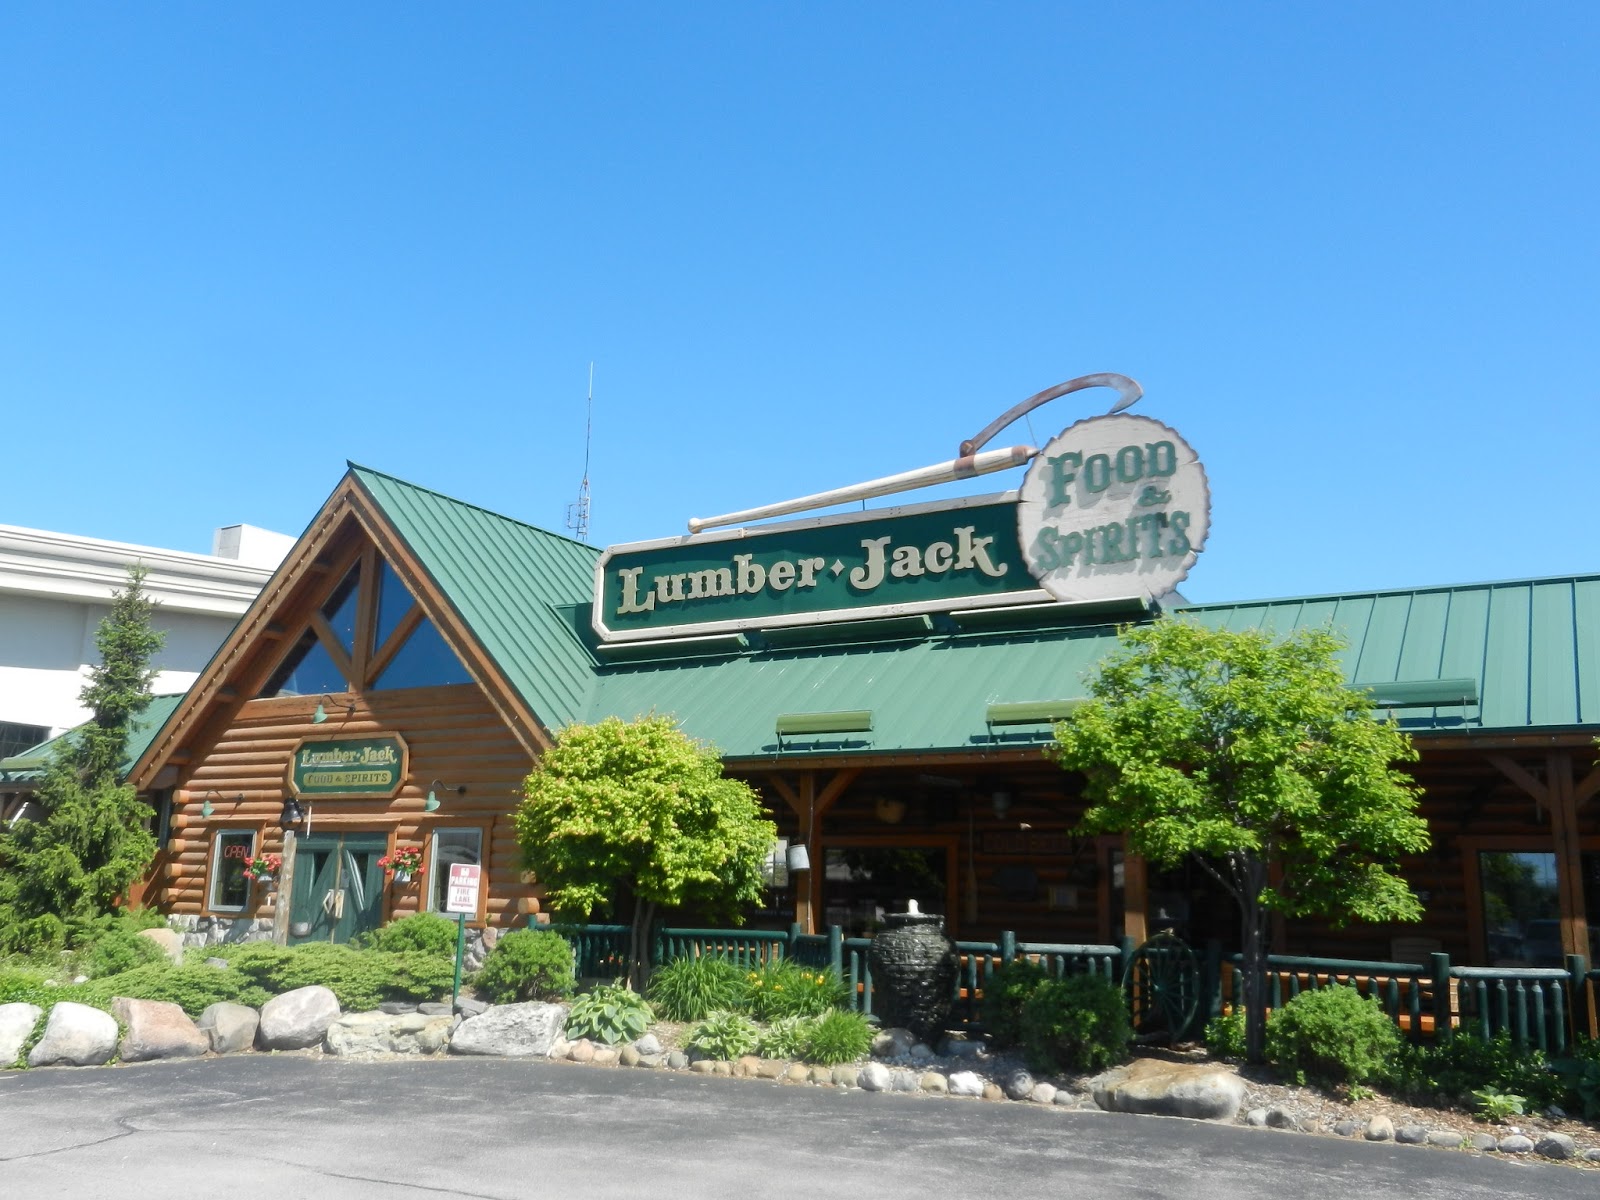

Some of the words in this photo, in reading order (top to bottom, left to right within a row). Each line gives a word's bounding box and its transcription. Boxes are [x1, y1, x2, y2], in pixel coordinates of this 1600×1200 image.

[1047, 440, 1178, 508] FOOD
[1137, 485, 1172, 507] &
[1036, 510, 1191, 571] SPIRITS
[617, 553, 826, 614] Lumber
[849, 525, 1008, 590] Jack
[301, 748, 357, 766] Lumber
[360, 746, 398, 764] Jack
[308, 774, 333, 784] FOOD
[344, 773, 388, 783] SPIRITS
[224, 845, 249, 858] OPEN
